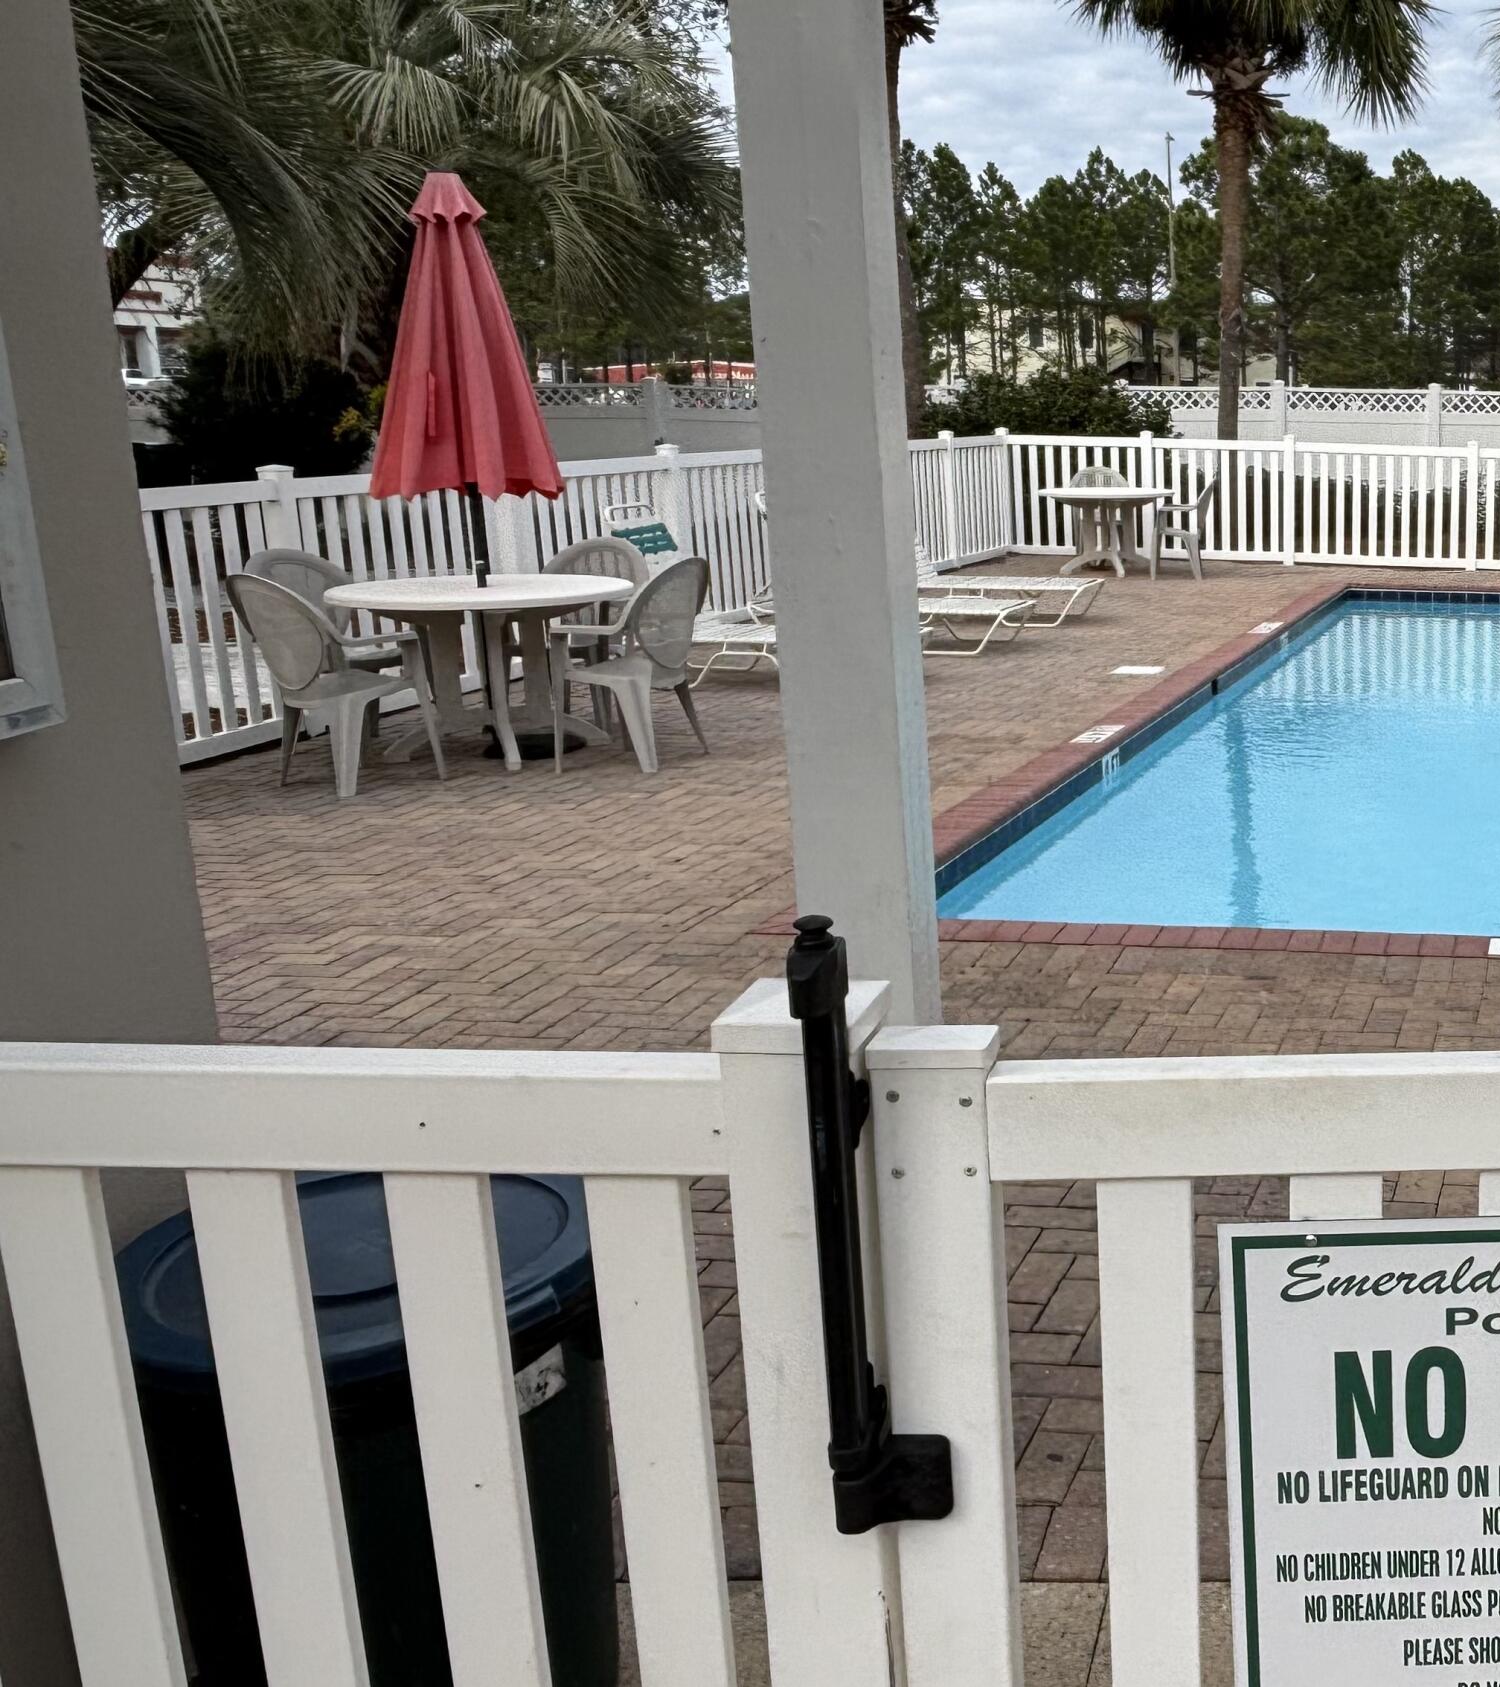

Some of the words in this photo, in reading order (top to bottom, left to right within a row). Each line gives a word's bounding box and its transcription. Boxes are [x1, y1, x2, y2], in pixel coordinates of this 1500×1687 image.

[1334, 1345, 1467, 1460] NO
[1277, 1470, 1310, 1505] NO
[1318, 1466, 1449, 1503] LIFEGUARD
[1457, 1464, 1490, 1499] ON
[1276, 1554, 1299, 1583] NO
[1303, 1550, 1382, 1582] CHILDREN
[1386, 1549, 1440, 1579] UNDER
[1446, 1548, 1466, 1577] 12
[1304, 1594, 1328, 1624] NO
[1332, 1591, 1427, 1622] BREAKABLE
[1431, 1589, 1483, 1619] GLASS
[1403, 1637, 1464, 1667] PLEASE
